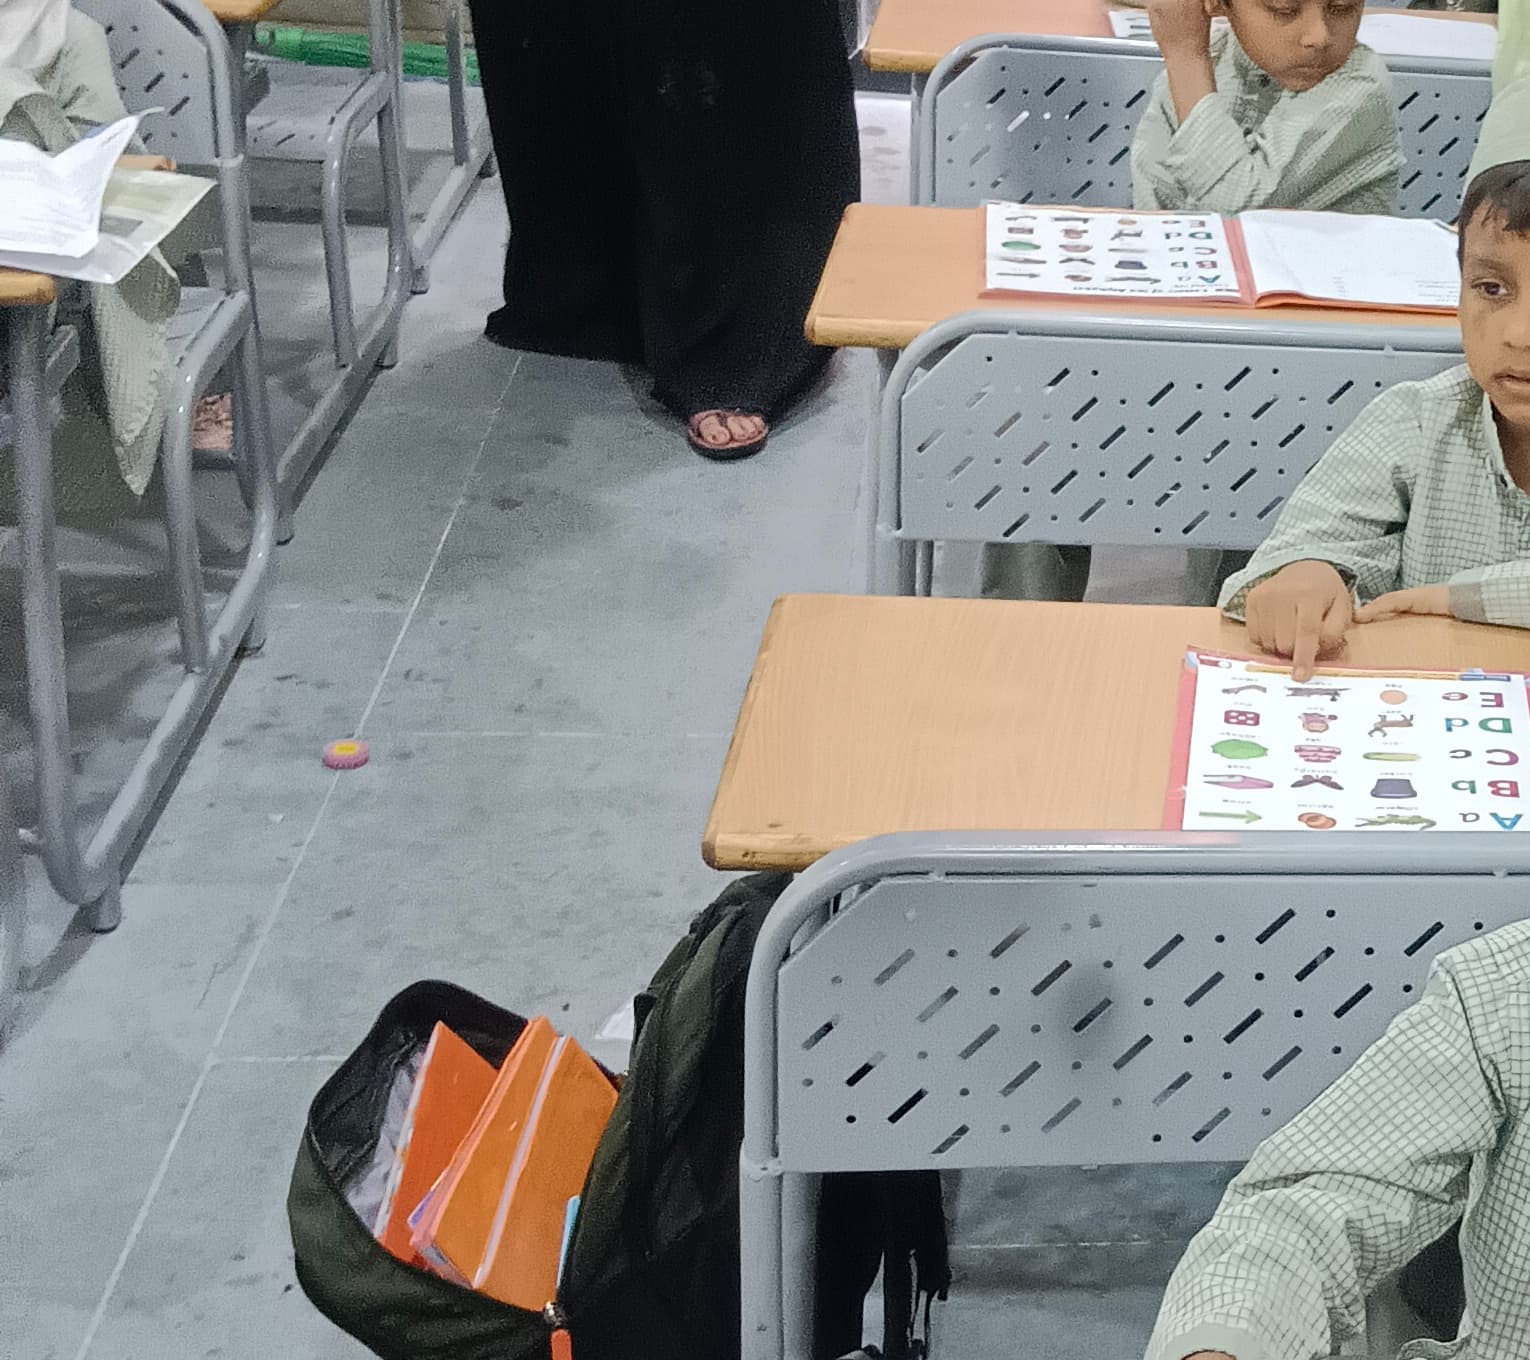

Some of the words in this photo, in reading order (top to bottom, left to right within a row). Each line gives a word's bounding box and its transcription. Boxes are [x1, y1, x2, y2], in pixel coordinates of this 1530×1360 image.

[1442, 692, 1468, 701] e
[1480, 692, 1504, 708] E
[1445, 718, 1469, 732] d
[1479, 718, 1512, 733] D
[1449, 750, 1472, 758] c
[1486, 749, 1519, 765] C
[1452, 780, 1476, 794] b
[1488, 780, 1520, 798] B
[1459, 813, 1480, 822] a
[1489, 813, 1523, 830] A
